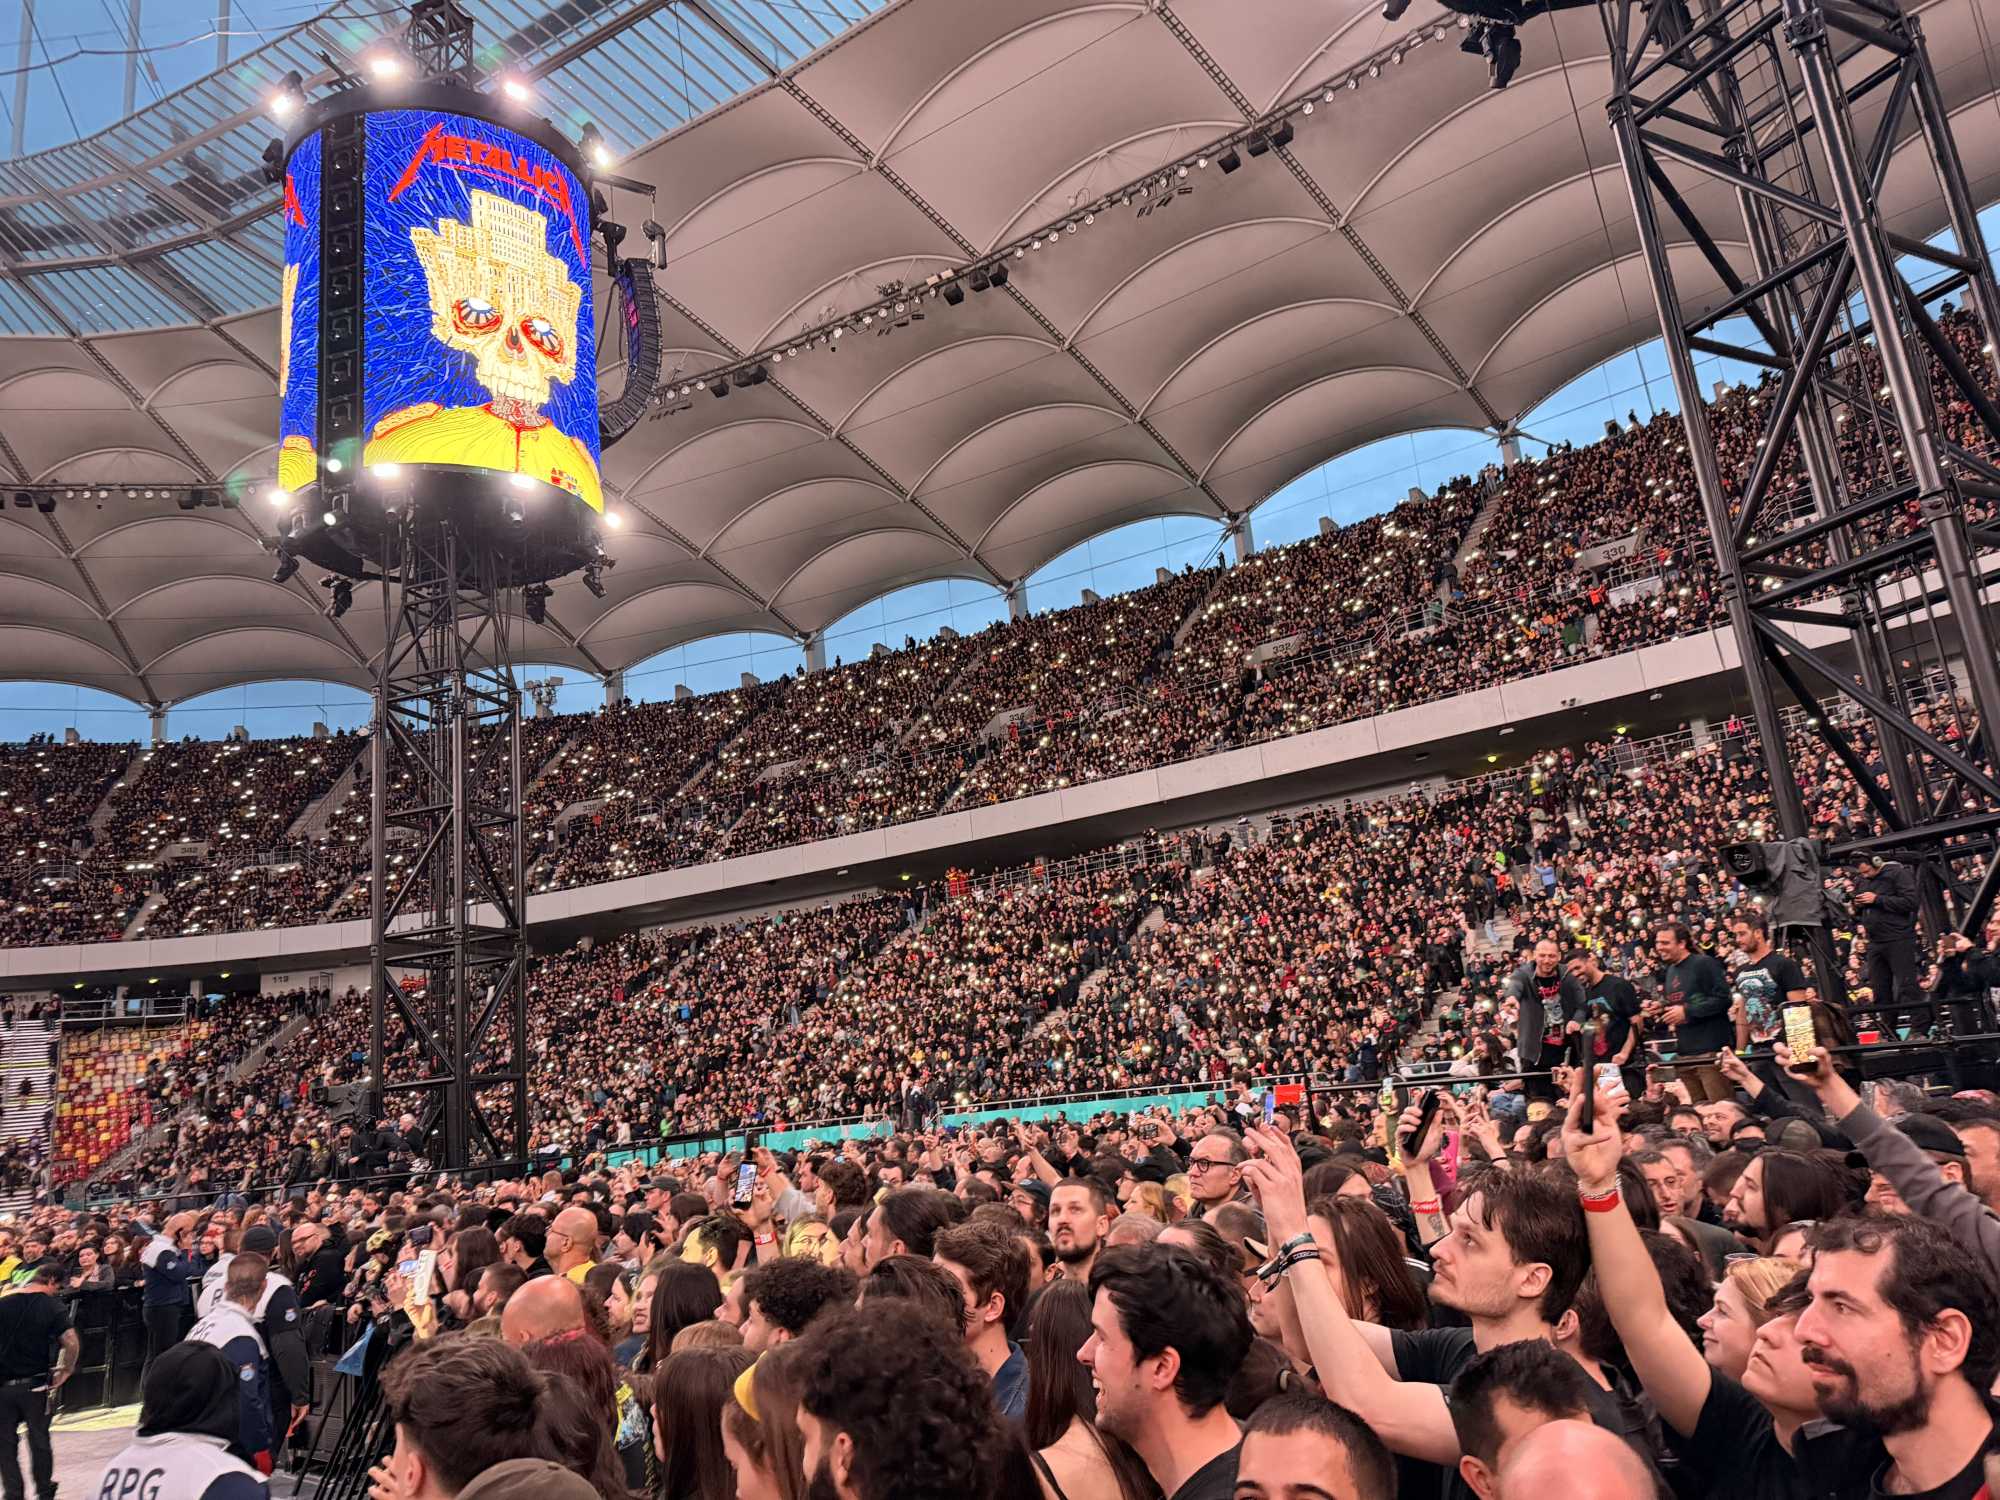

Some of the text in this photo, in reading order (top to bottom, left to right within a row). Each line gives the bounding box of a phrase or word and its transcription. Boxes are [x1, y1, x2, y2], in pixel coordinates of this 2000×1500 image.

[388, 121, 587, 272] METALLICA
[1602, 545, 1627, 560] 330
[1272, 642, 1291, 654] 332
[99, 1467, 165, 1500] RPG
